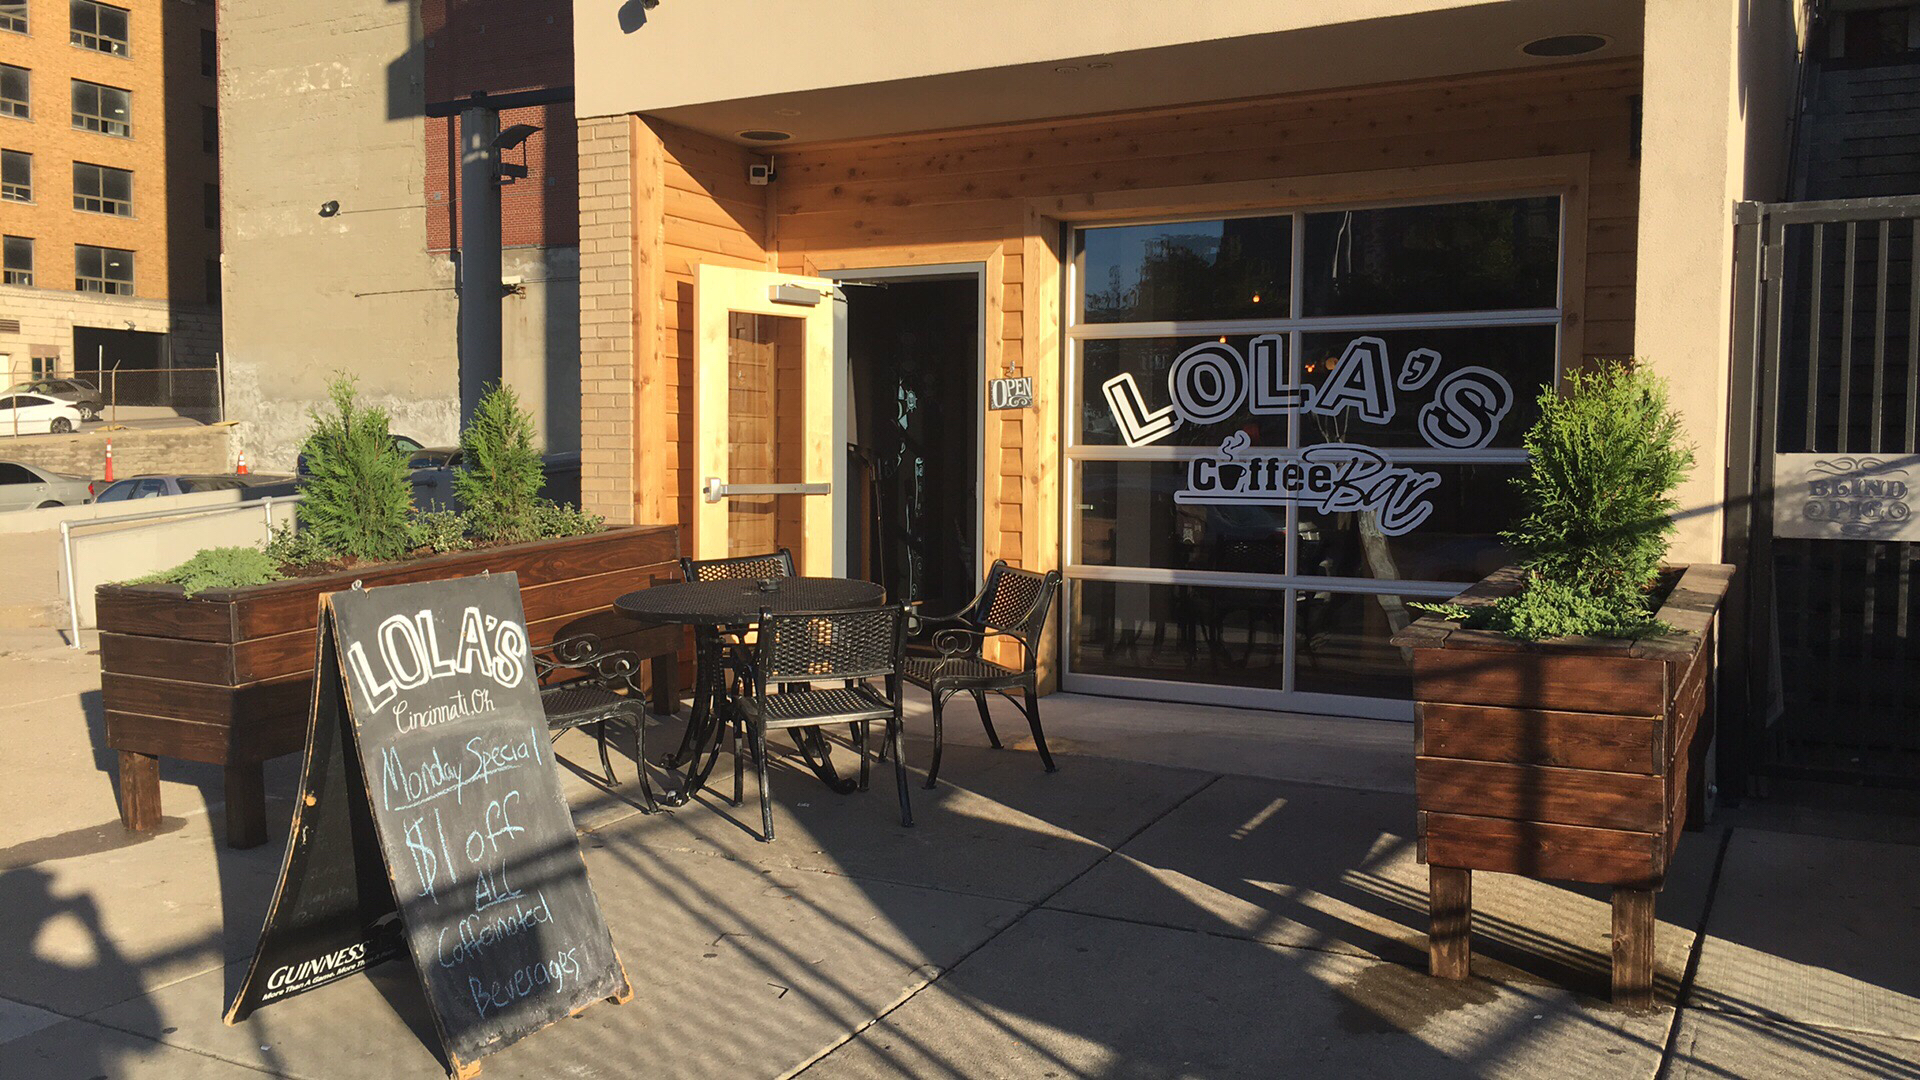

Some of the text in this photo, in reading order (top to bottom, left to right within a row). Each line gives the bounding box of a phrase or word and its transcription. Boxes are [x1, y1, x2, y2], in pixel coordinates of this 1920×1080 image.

[992, 377, 1032, 408] OPEN
[1102, 334, 1514, 450] LOLA'S
[1302, 443, 1441, 536] Bar
[1808, 479, 1909, 500] BLIND
[1829, 500, 1885, 521] PIG
[347, 606, 528, 715] LOLA'S
[381, 726, 543, 812] Monday Special
[403, 790, 525, 906] $1 off
[475, 858, 522, 911] ALL
[261, 988, 285, 1001] More
[285, 981, 304, 994] Than
[336, 963, 357, 976] More
[267, 941, 370, 990] GUINNESS
[468, 947, 579, 1019] Beverages
